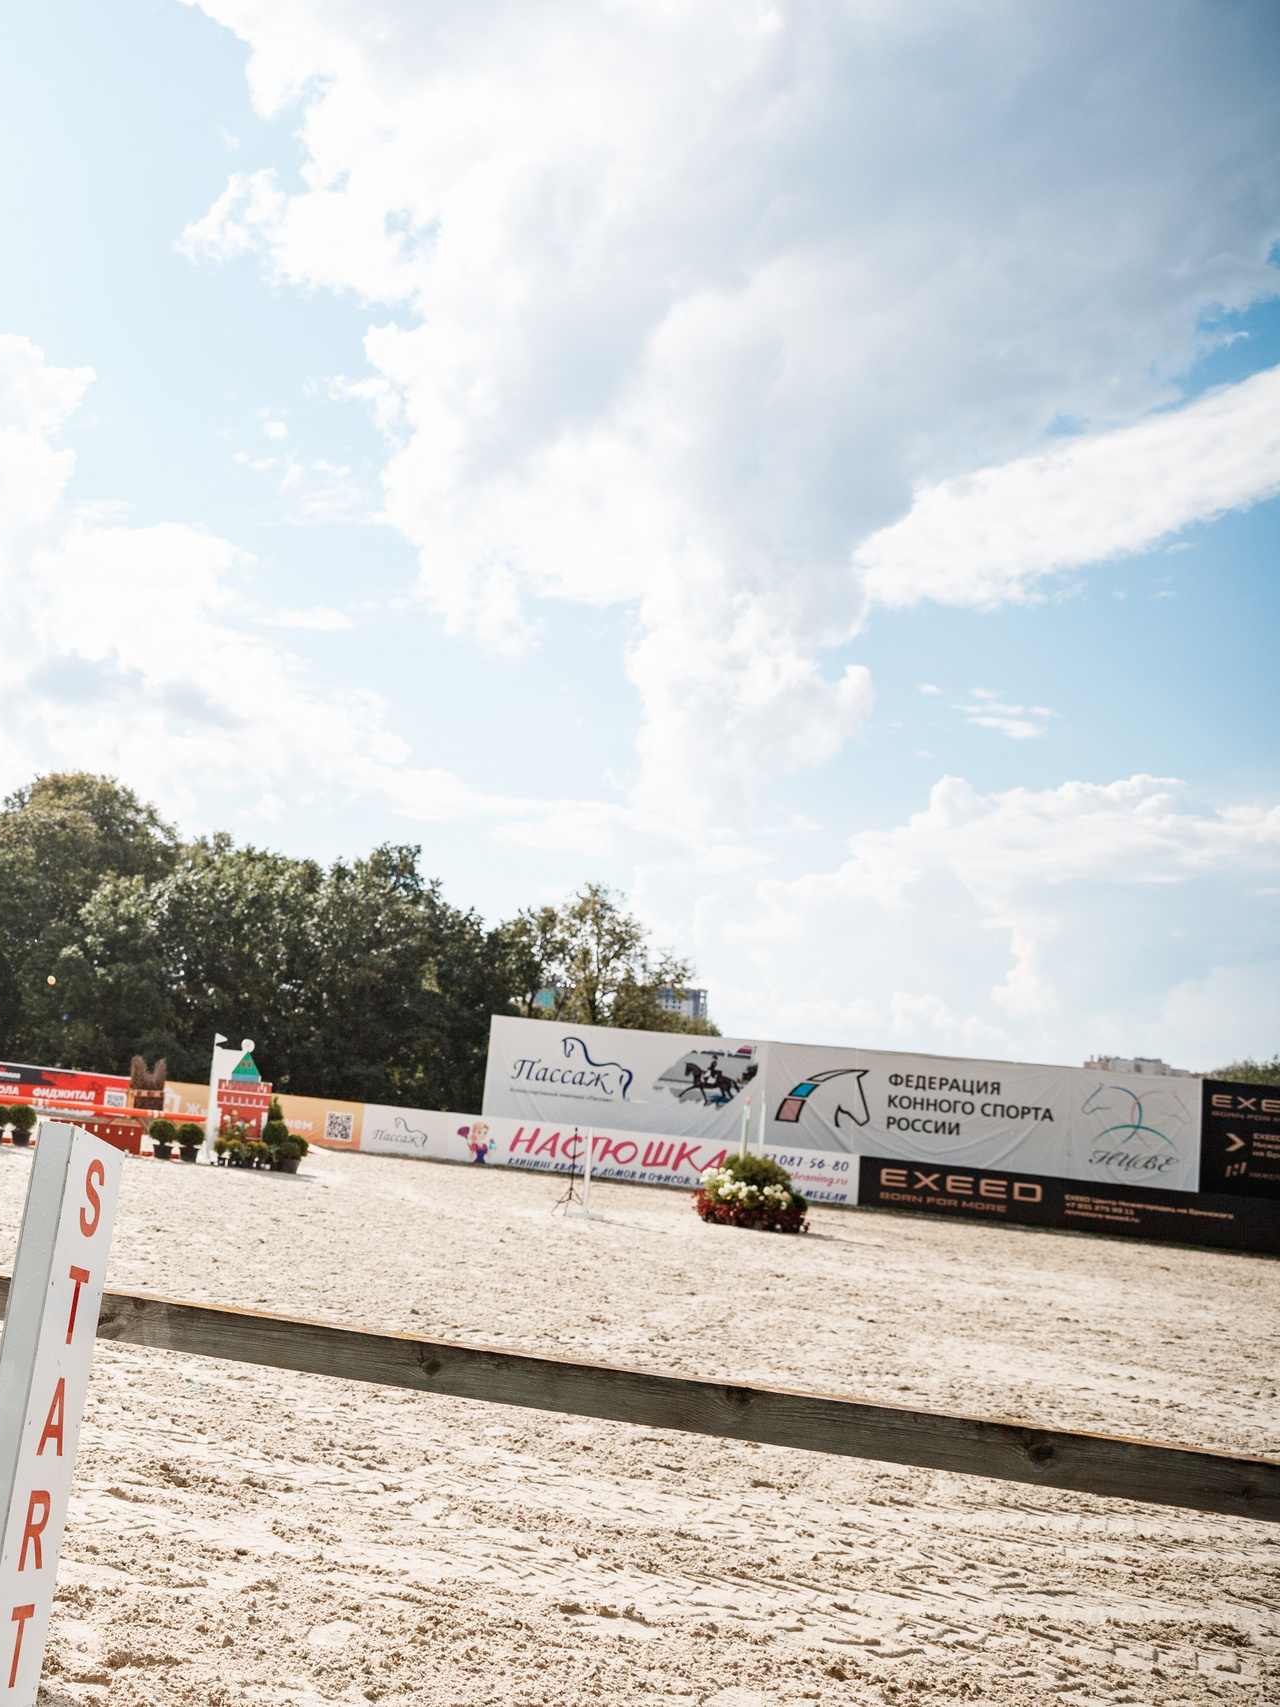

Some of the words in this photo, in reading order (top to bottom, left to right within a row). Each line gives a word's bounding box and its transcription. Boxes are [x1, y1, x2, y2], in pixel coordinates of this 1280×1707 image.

[511, 1059, 613, 1095] Пассаж
[888, 1073, 1001, 1096] ФЕДЕРАЦИЯ
[32, 1086, 96, 1101] ФИДЖИТАЛ
[887, 1095, 975, 1116] КОННОГО
[980, 1102, 1054, 1122] СПОРТА
[886, 1116, 961, 1136] РОССИИ
[372, 1129, 421, 1147] Пассаж
[601, 1168, 637, 1180] ДОМОВ
[880, 1168, 1043, 1203] EXEED
[879, 1191, 923, 1203] BORN
[925, 1196, 959, 1208] FOR
[961, 1200, 1008, 1214] MORE
[17, 1158, 105, 1689] START
